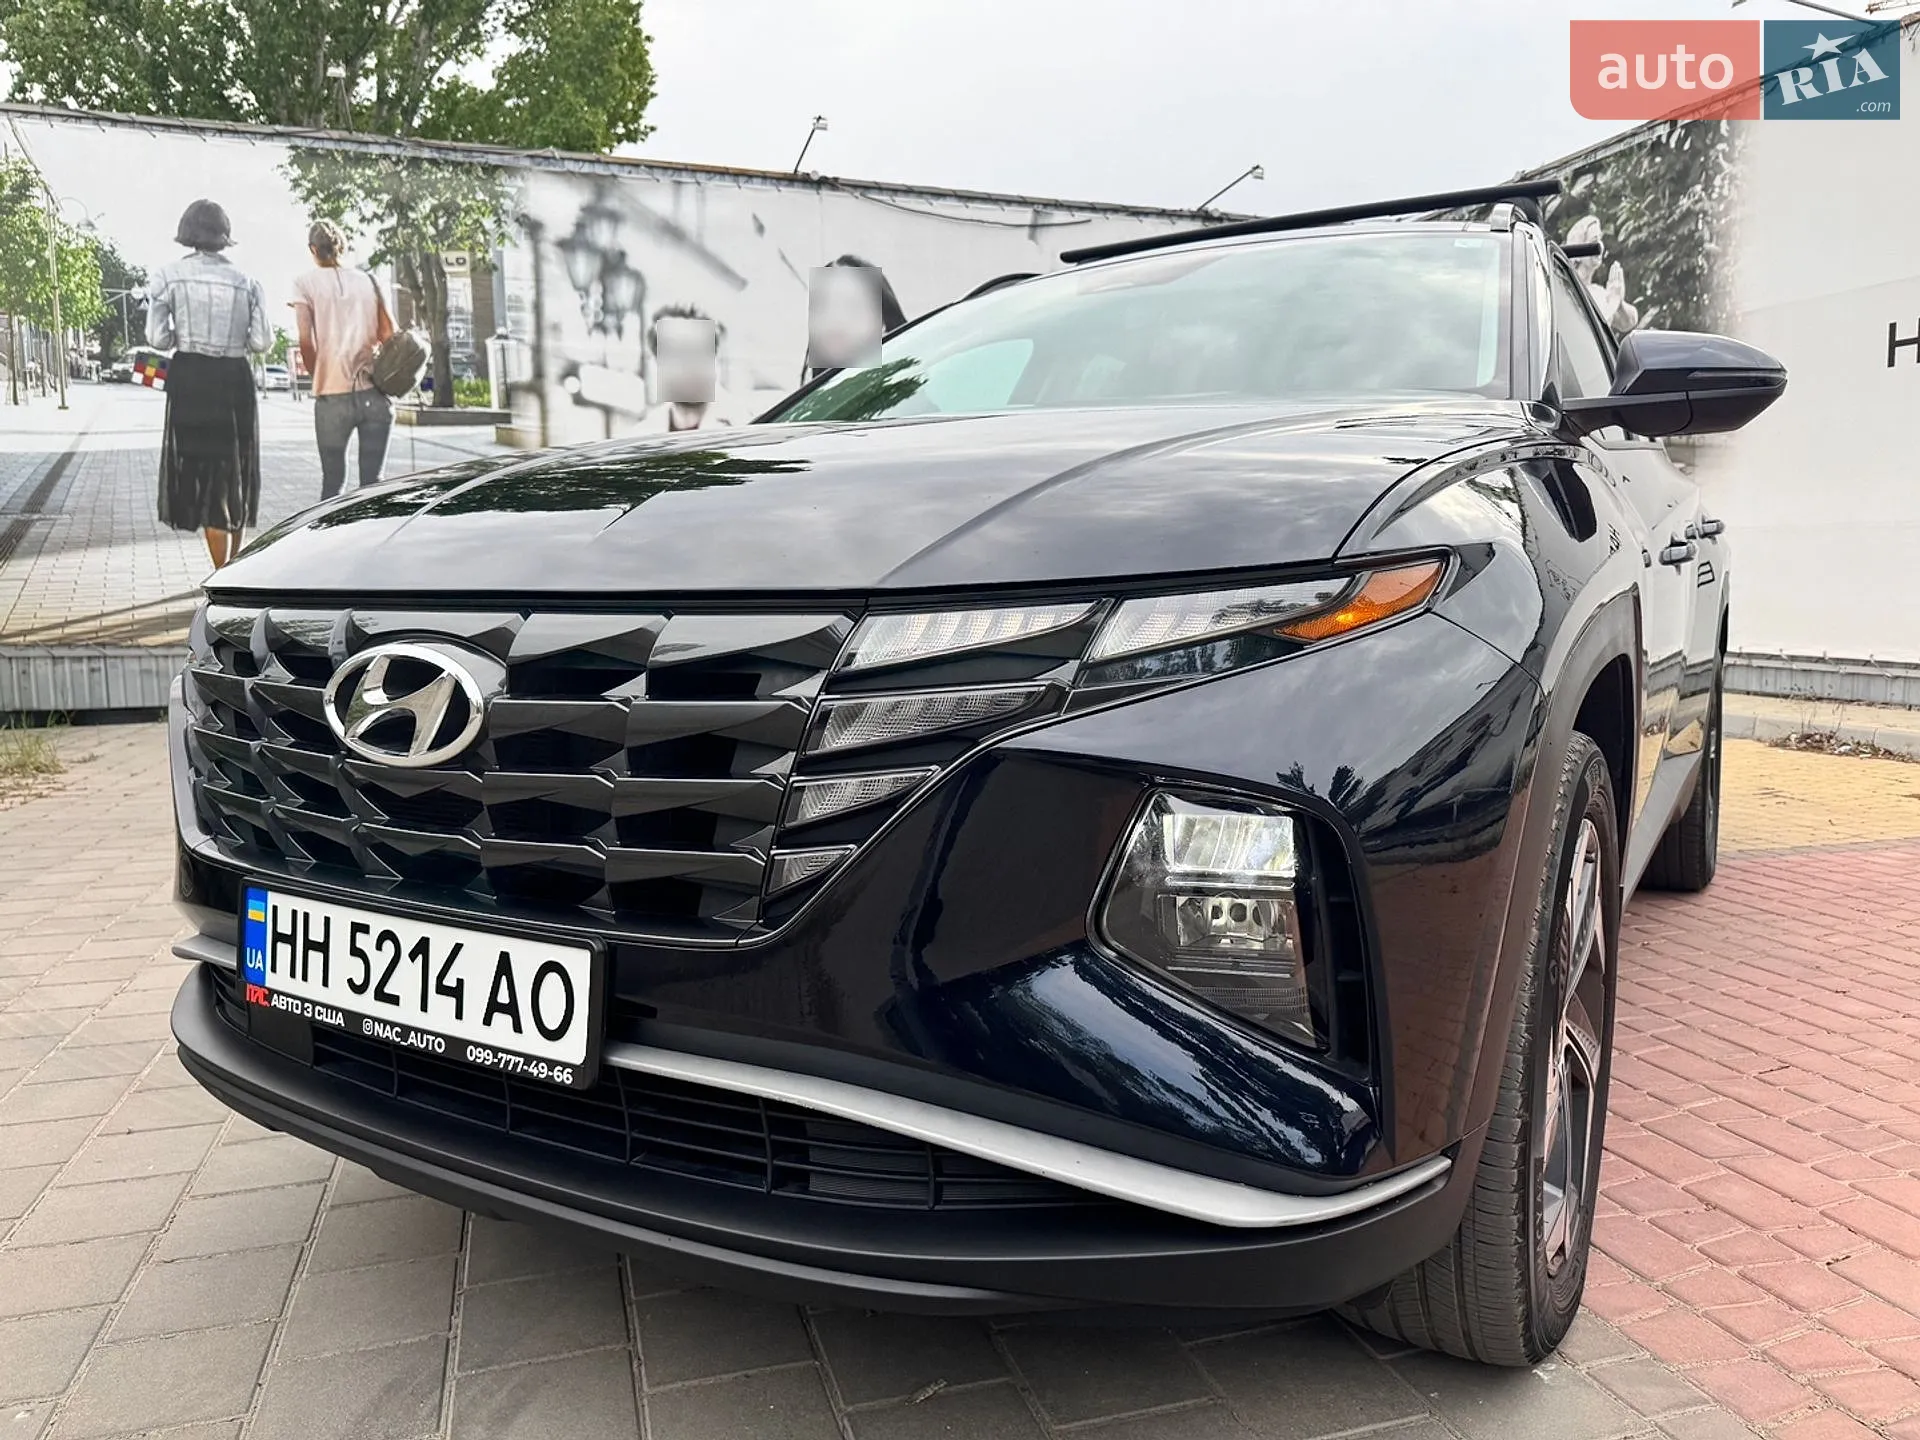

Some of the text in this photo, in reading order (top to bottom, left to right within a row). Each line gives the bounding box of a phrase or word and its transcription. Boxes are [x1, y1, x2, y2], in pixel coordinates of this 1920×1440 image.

[246, 947, 264, 972] UA
[270, 904, 575, 1041] HH 5214 AO
[271, 993, 302, 1014] АВТО
[314, 1005, 345, 1026] США
[466, 1045, 574, 1084] 099-777-49-66
